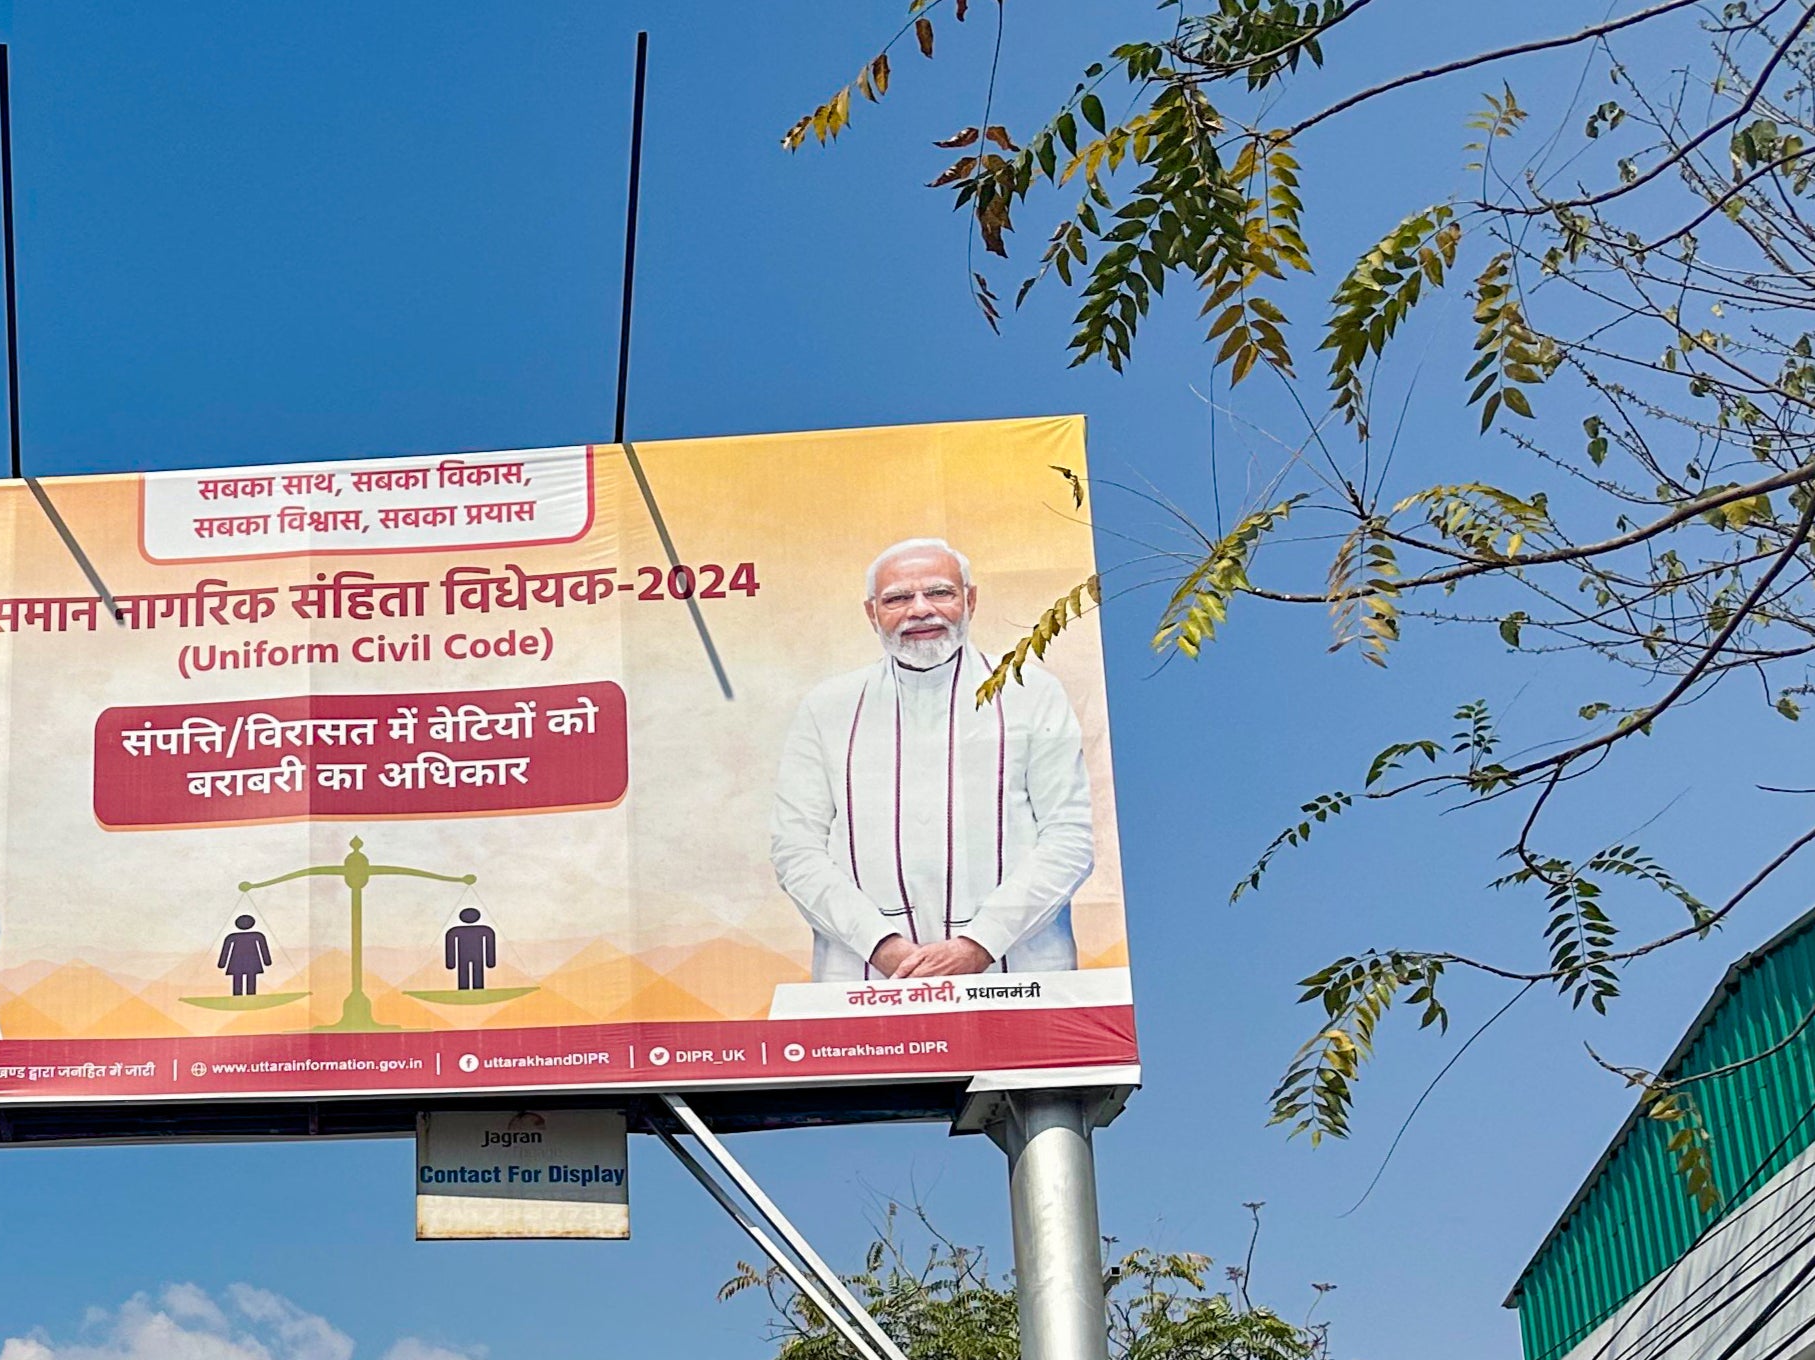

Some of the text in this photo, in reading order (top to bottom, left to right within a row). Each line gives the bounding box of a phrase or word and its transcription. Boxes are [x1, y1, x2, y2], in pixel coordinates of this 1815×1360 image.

[198, 460, 533, 501] सबका साथ, सबका विकास,
[193, 500, 538, 540] सबका विश्वास, सबका प्रयास
[112, 577, 280, 631] नागरिक
[288, 571, 431, 623] संहिता
[441, 562, 761, 617] विधेयक-2024
[178, 627, 554, 679] (Uniform Civil Code)
[121, 697, 600, 759] संपत्ति/विरासत में बेटियों को
[186, 753, 531, 799] बराबरी का अधिकार
[847, 980, 1041, 1007] नरेन्द्र मोदी, प्रधानमंत्री
[483, 1052, 610, 1069] uttarakhandDIPR
[675, 1048, 746, 1066] DIPR_UK
[811, 1040, 948, 1059] uttarakhand DIPR
[27, 1064, 55, 1083] द्वारा
[58, 1062, 108, 1079] जनहित
[125, 1060, 156, 1078] जारी
[212, 1056, 423, 1074] www.uttarainformation.gov.in
[481, 1130, 542, 1147] Jagran
[420, 1165, 625, 1187] Contact For Display
